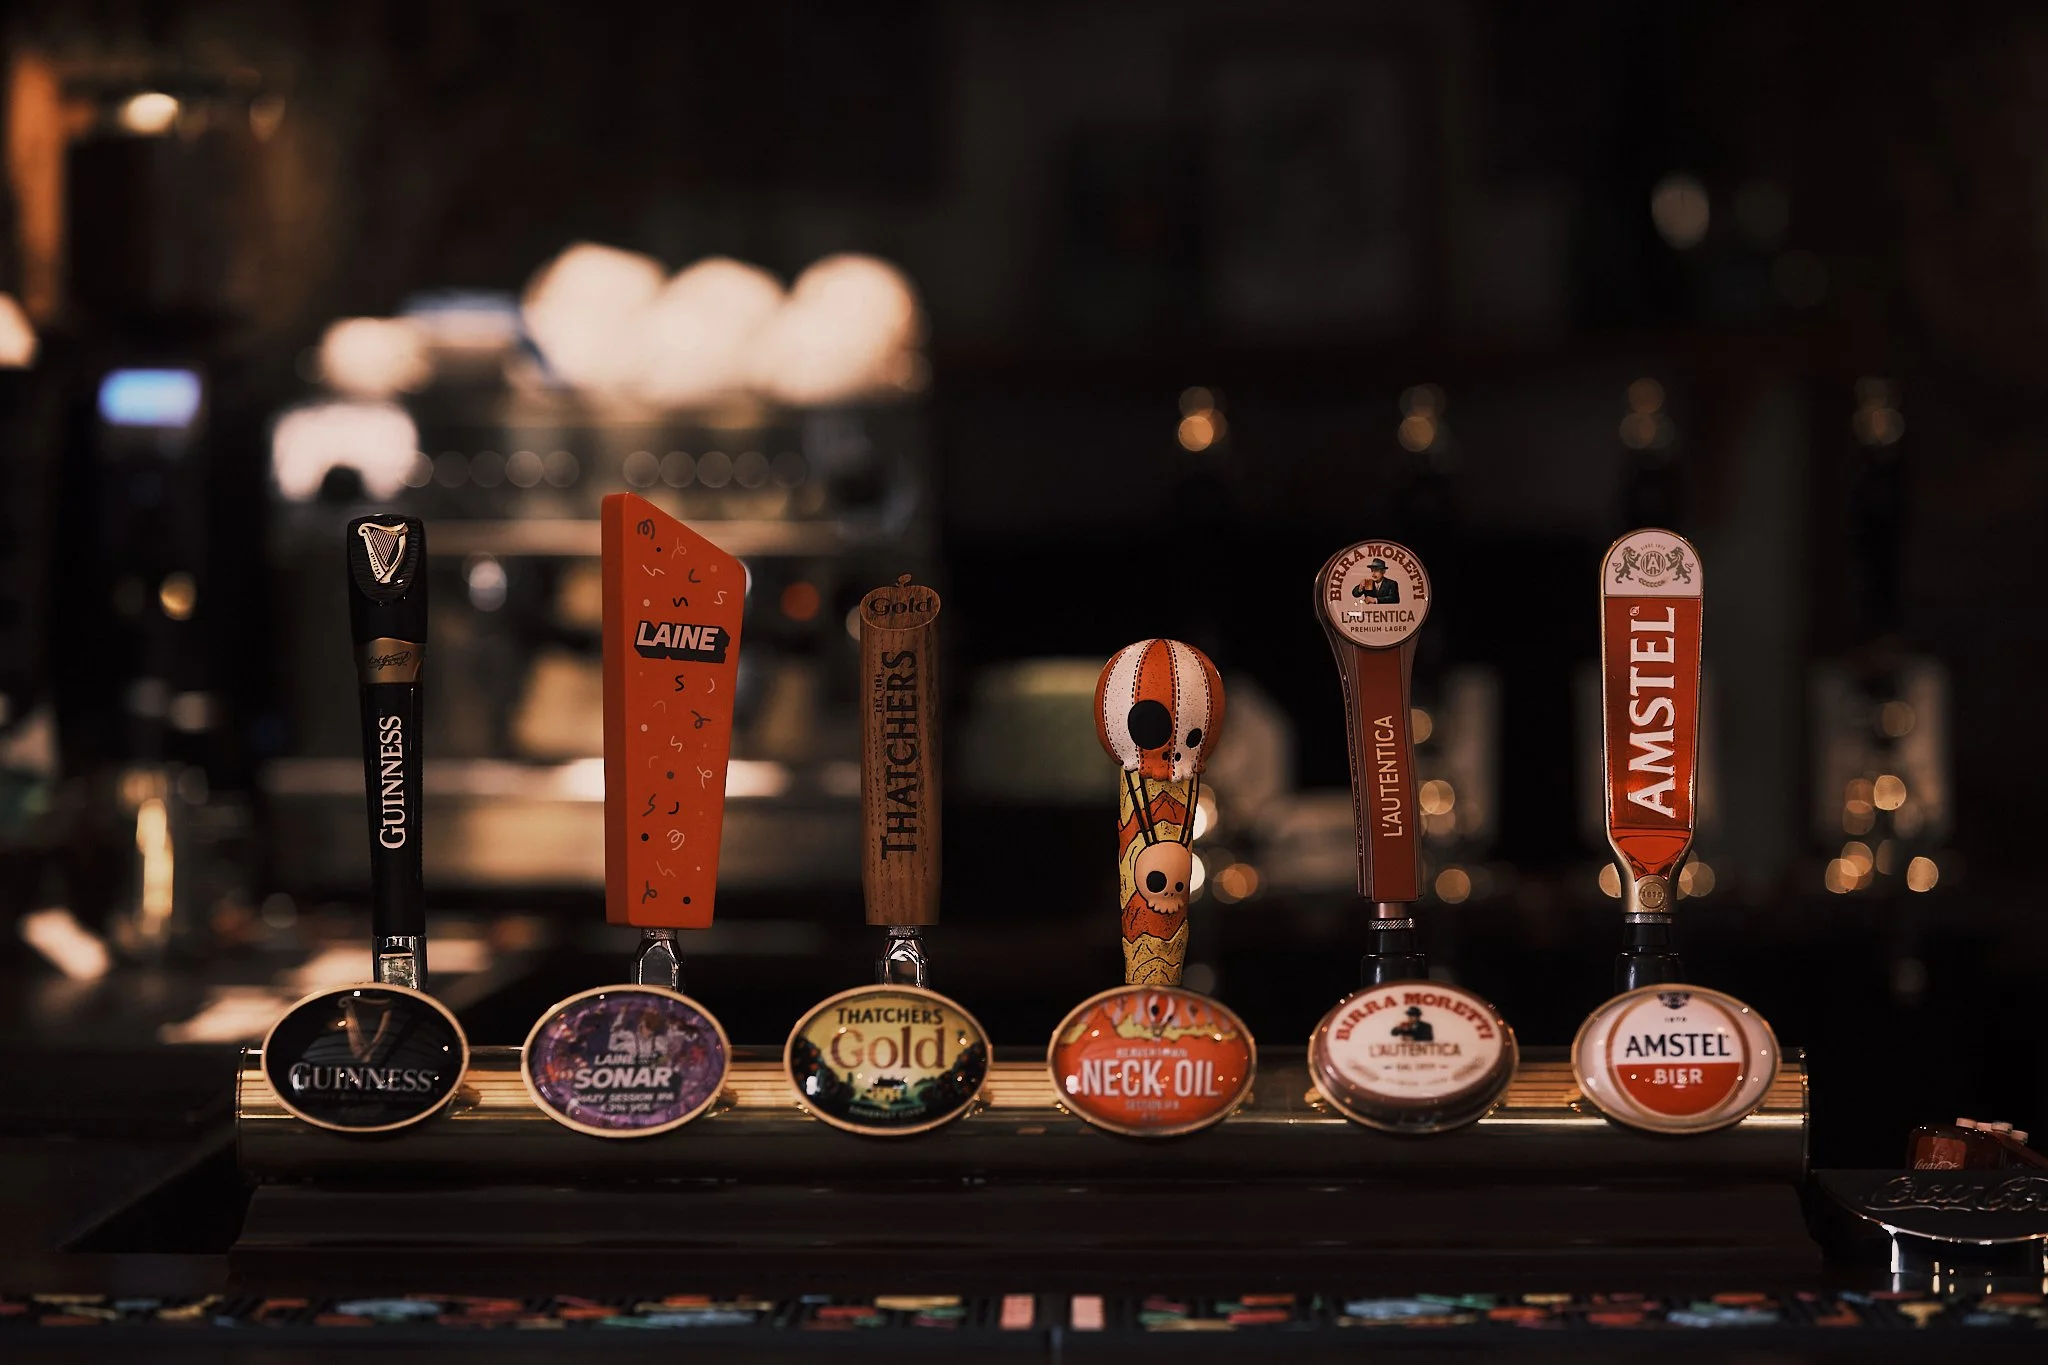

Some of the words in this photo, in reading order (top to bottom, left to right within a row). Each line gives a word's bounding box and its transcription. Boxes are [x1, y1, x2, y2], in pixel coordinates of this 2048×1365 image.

[1329, 549, 1366, 602] BIRRA
[1367, 545, 1425, 600] MORETTI
[869, 597, 932, 616] Gold
[635, 621, 722, 653] LAINE
[1627, 606, 1676, 819] AMSTEL
[880, 650, 918, 860] THATCHERS
[378, 714, 406, 850] GUINNESS
[1373, 715, 1403, 837] L'AUTENTICA
[836, 1007, 945, 1025] THATCHERS
[1335, 995, 1398, 1041] BIRRA
[1404, 993, 1494, 1040] MORETTI
[594, 1054, 636, 1066] LAINE
[830, 1026, 946, 1069] Gold
[1369, 1043, 1461, 1057] L'AUTENTICA
[1626, 1033, 1732, 1058] AMSTEL
[288, 1060, 433, 1093] GUINNESS
[573, 1066, 674, 1091] SONAR
[1082, 1058, 1164, 1098] NECK
[1174, 1058, 1220, 1098] OIL
[1655, 1068, 1703, 1086] BIER
